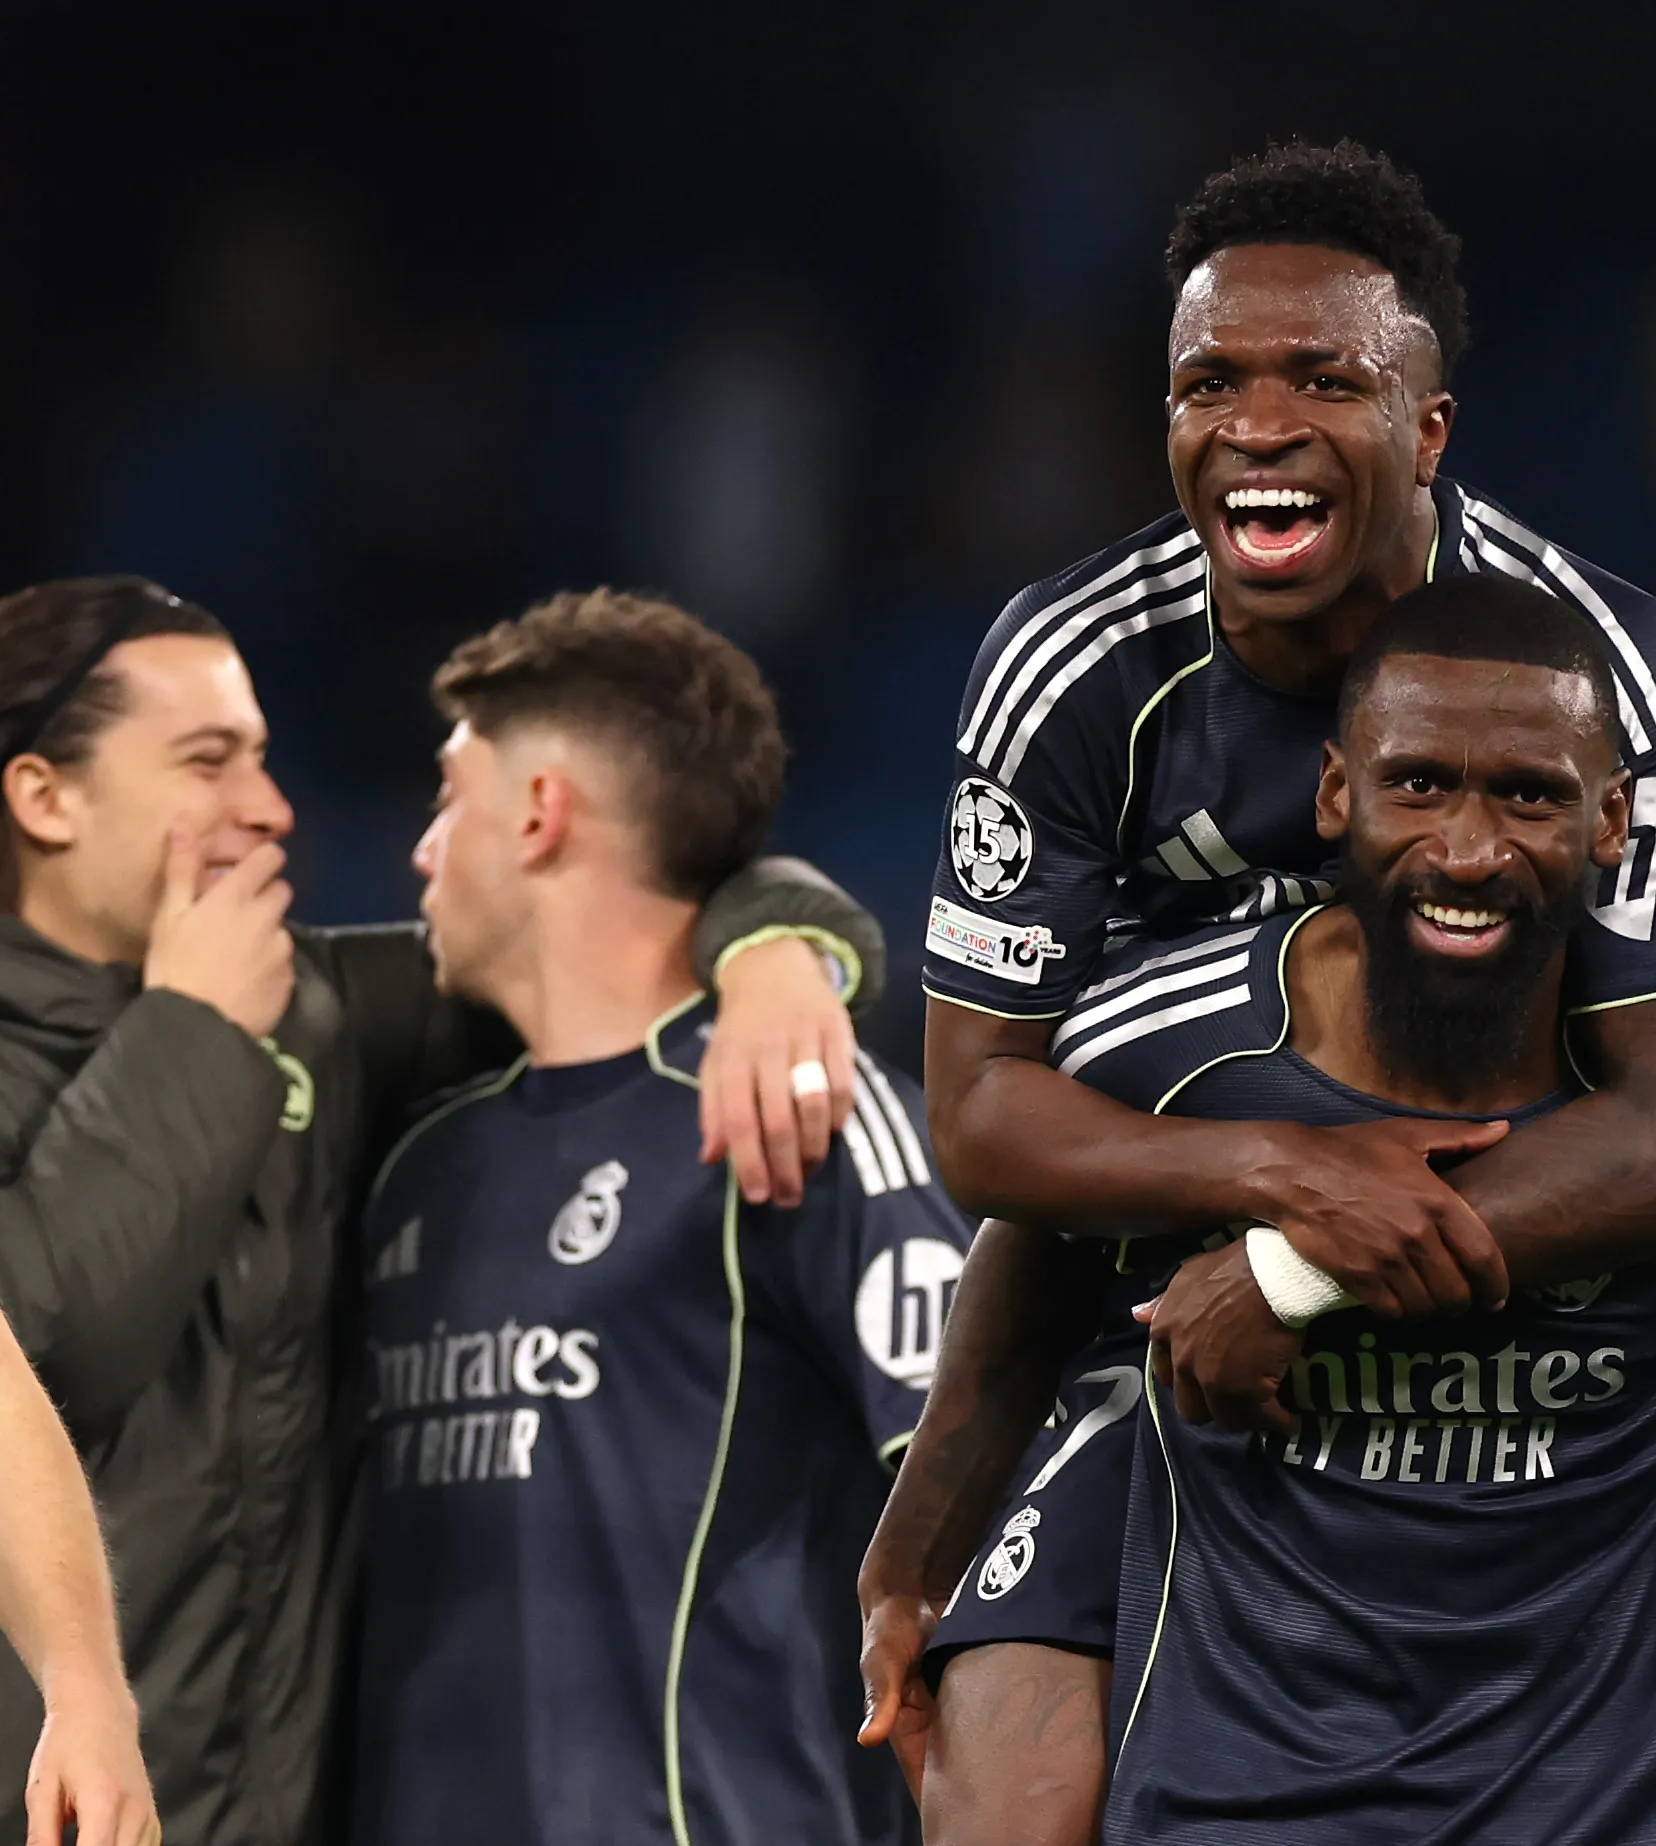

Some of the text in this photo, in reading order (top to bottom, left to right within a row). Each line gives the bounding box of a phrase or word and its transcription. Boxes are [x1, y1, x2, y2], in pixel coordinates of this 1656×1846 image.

[964, 810, 1001, 864] 15
[930, 917, 996, 954] FOUNDATION
[1000, 936, 1039, 968] 10
[889, 1243, 958, 1359] h
[368, 1316, 600, 1412] mirates
[1360, 1415, 1558, 1483] BETTER
